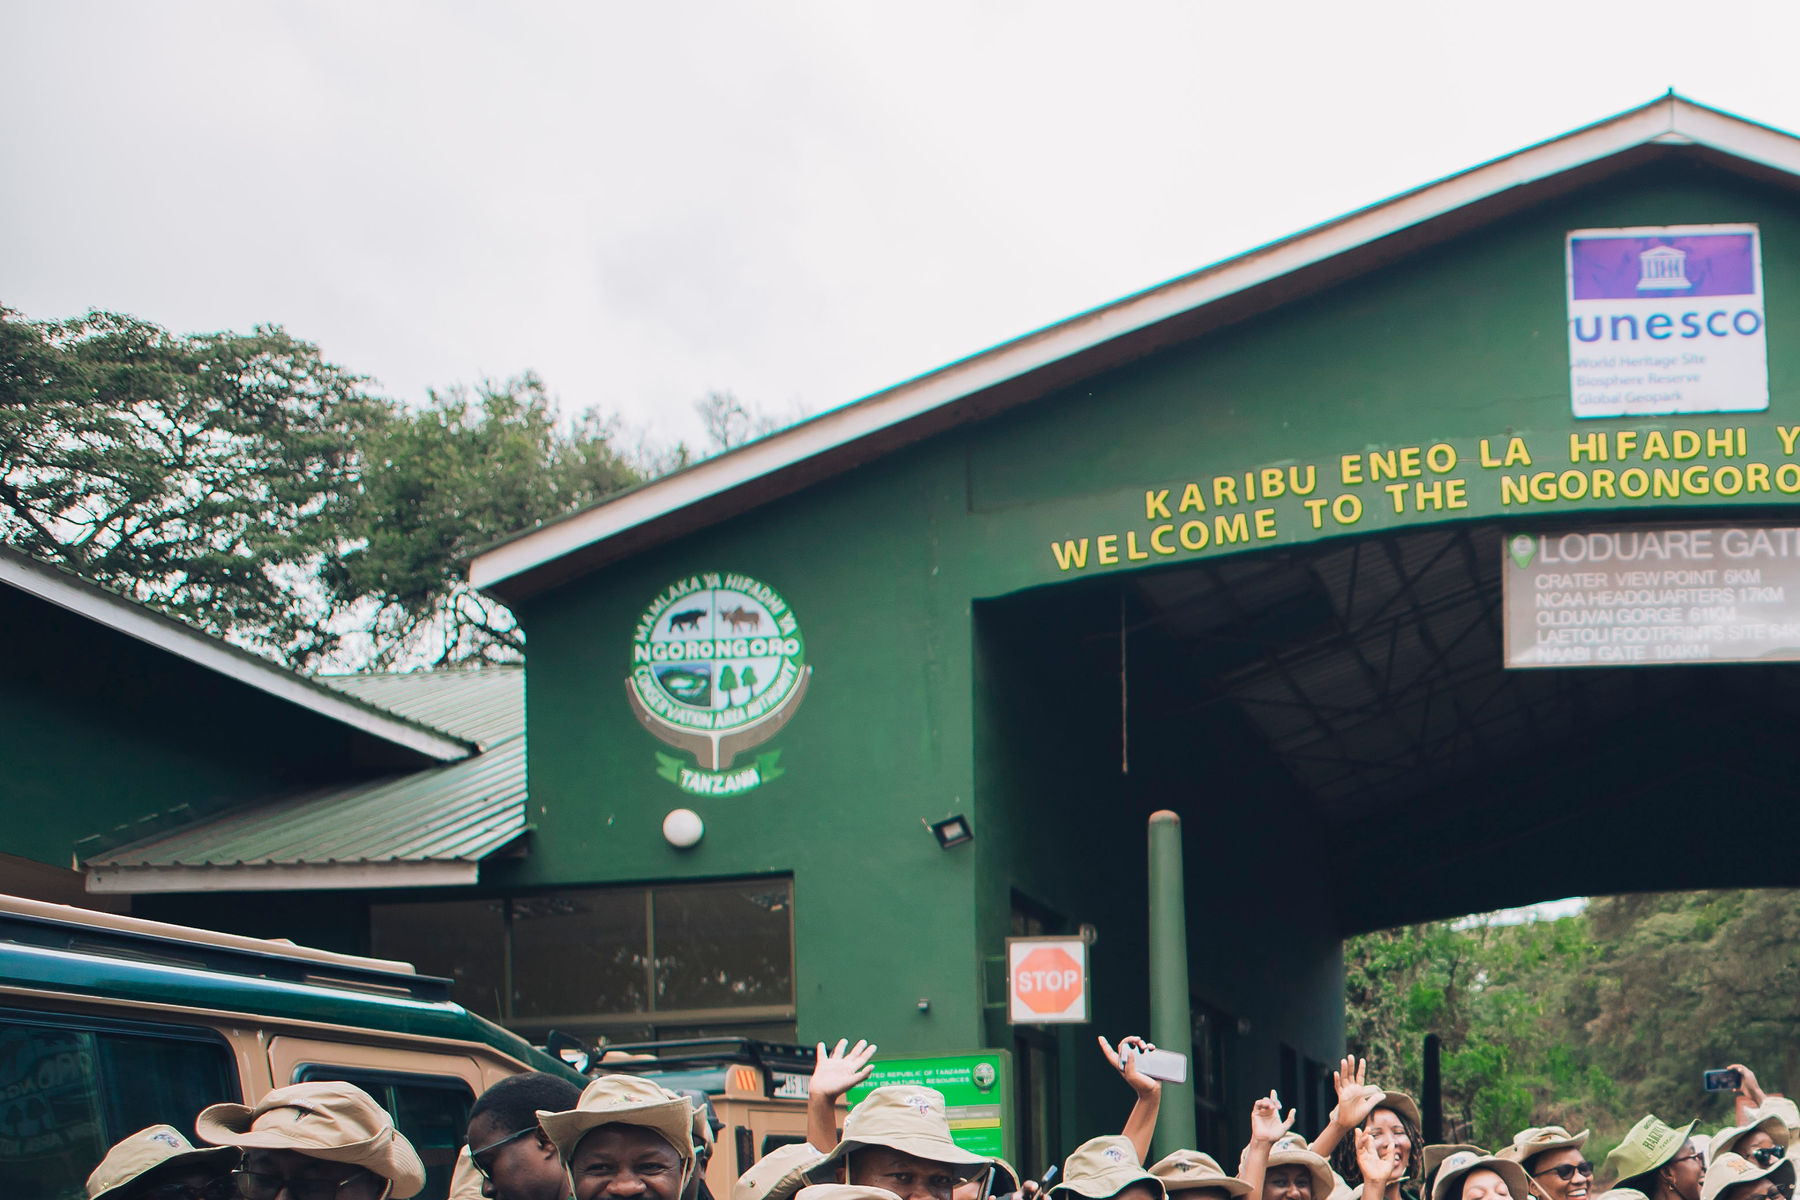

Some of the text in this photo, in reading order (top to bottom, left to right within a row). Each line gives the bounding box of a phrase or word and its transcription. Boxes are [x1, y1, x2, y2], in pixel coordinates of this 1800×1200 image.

[1574, 309, 1761, 342] unesco
[1575, 353, 1706, 370] World Heritage Site
[1576, 372, 1700, 388] Biosphere Reserve
[1577, 390, 1683, 405] Global Geopark
[1145, 465, 1316, 519] KARIBU
[1341, 443, 1457, 484] ENEO
[1480, 437, 1532, 467] LA
[1570, 427, 1747, 463] HIFADHI
[1051, 508, 1277, 570] WELCOME
[1303, 494, 1363, 529] TO
[1385, 479, 1468, 513] THE
[1540, 529, 1714, 563] LODUARE
[702, 572, 722, 590] YA
[1535, 568, 1761, 589] CRATER VIEW POINT 6KM
[1535, 586, 1785, 608] NCAA HEADQUARTERS 17KM
[1536, 606, 1737, 626] OLDUVAI GORGE 61KM
[1537, 627, 1612, 645] LAETOLI
[1613, 625, 1724, 643] FOOTPRINTS
[1728, 623, 1766, 640] SITE
[634, 636, 801, 663] NGORONGORO
[1598, 645, 1646, 661] GATE
[1655, 643, 1710, 660] 104KM
[680, 767, 760, 796] TANZANIA
[1018, 969, 1078, 993] STOP
[886, 1070, 921, 1079] REPUBLIC
[924, 1069, 933, 1077] OF
[935, 1067, 971, 1076] TANZANIA
[926, 1076, 970, 1085] RESOURCES
